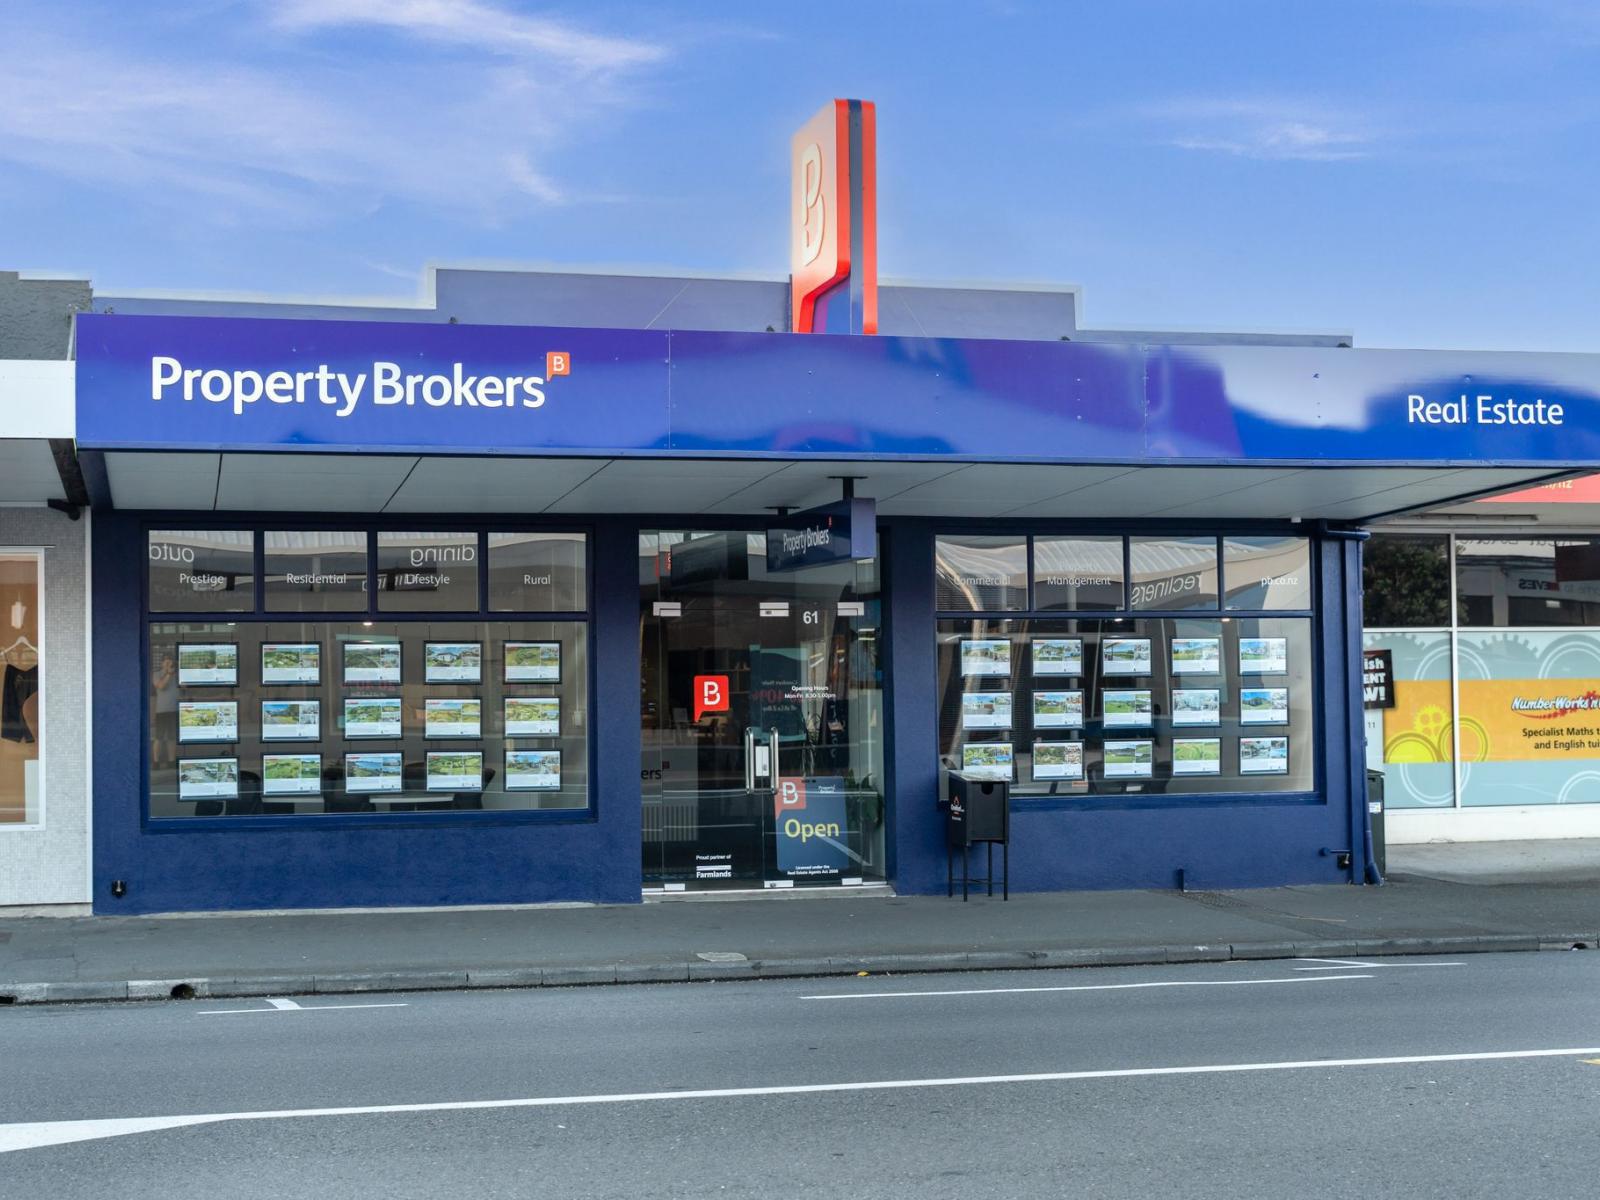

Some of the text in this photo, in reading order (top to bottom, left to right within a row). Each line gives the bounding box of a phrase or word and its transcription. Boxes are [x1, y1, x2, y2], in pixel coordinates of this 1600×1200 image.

[553, 355, 565, 372] B
[152, 356, 545, 417] Property Brokers
[1407, 394, 1564, 425] Real Estate
[783, 525, 830, 556] Property Brokers
[179, 573, 225, 587] Prestige
[286, 573, 347, 584] Residential
[406, 574, 450, 587] Lifestyle
[524, 574, 551, 585] Rural
[953, 575, 1011, 586] Commercial
[1047, 576, 1112, 588] Management
[1261, 576, 1298, 588] pb.co.nz
[803, 610, 819, 624] 61
[1363, 672, 1386, 684] ENT
[704, 681, 720, 705] B
[1522, 727, 1564, 738] Specialist
[1566, 727, 1594, 736] Maths
[1534, 740, 1551, 749] and
[1553, 740, 1586, 751] English
[782, 782, 799, 804] B
[784, 818, 840, 843] Open
[696, 870, 732, 879] Farmlands
